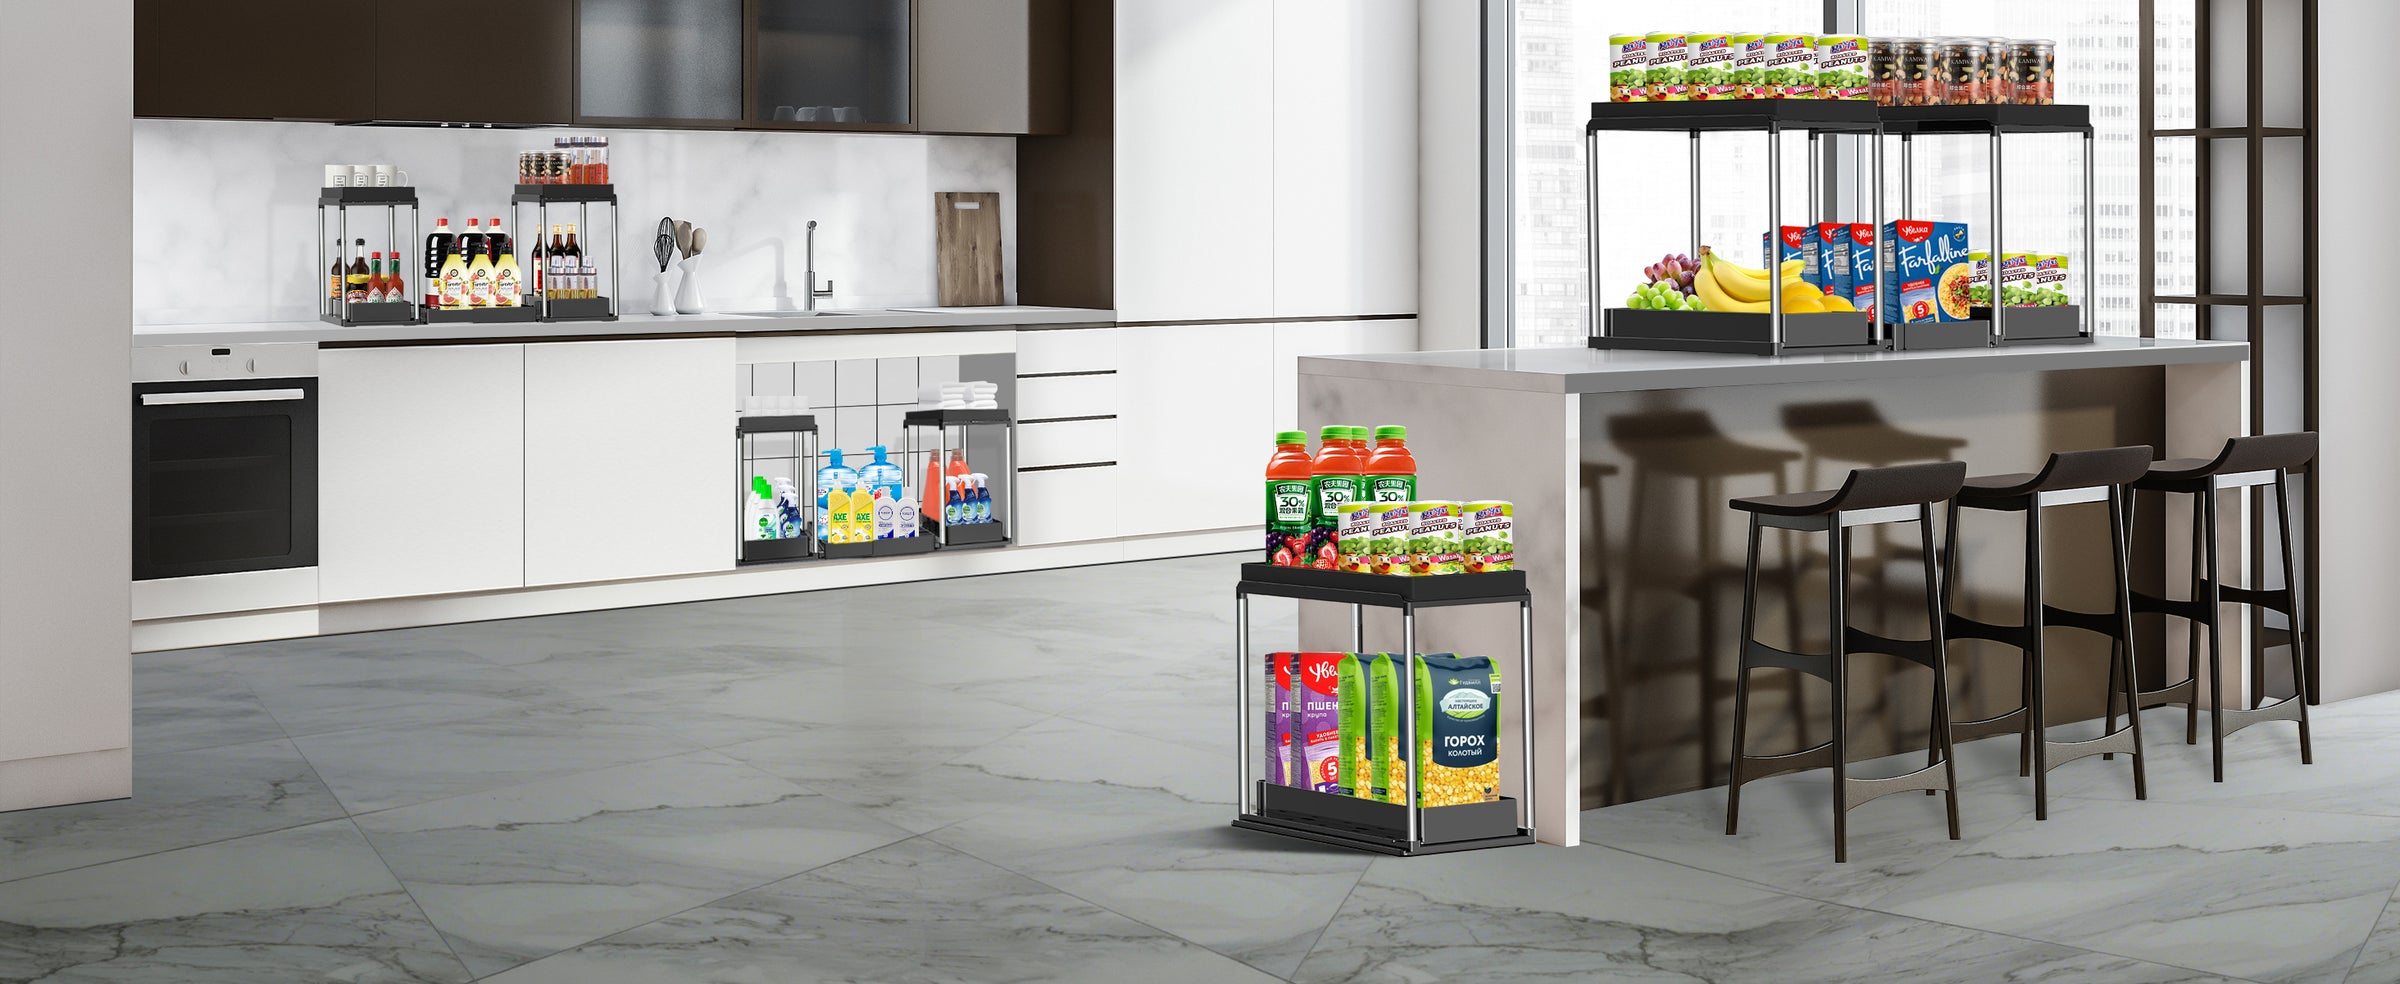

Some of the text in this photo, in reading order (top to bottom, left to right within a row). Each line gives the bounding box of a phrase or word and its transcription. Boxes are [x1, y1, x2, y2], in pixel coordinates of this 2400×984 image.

[1691, 53, 1734, 66] PEANUTS
[1767, 53, 1812, 66] PEANUTS
[1821, 55, 1867, 68] PEANUTS
[1898, 234, 1968, 277] Farfalline
[2002, 271, 2035, 282] ANUTS
[1917, 304, 1925, 314] 5
[1280, 496, 1305, 507] 30%
[1325, 491, 1350, 503] 30%
[1380, 491, 1405, 502] 30%
[1412, 522, 1457, 535] PEANUTS
[1466, 522, 1511, 535] PEANUTS
[1448, 702, 1484, 710] АЛТАЙСКОЕ
[1444, 735, 1485, 747] ГОРОХ
[1327, 762, 1337, 776] 5
